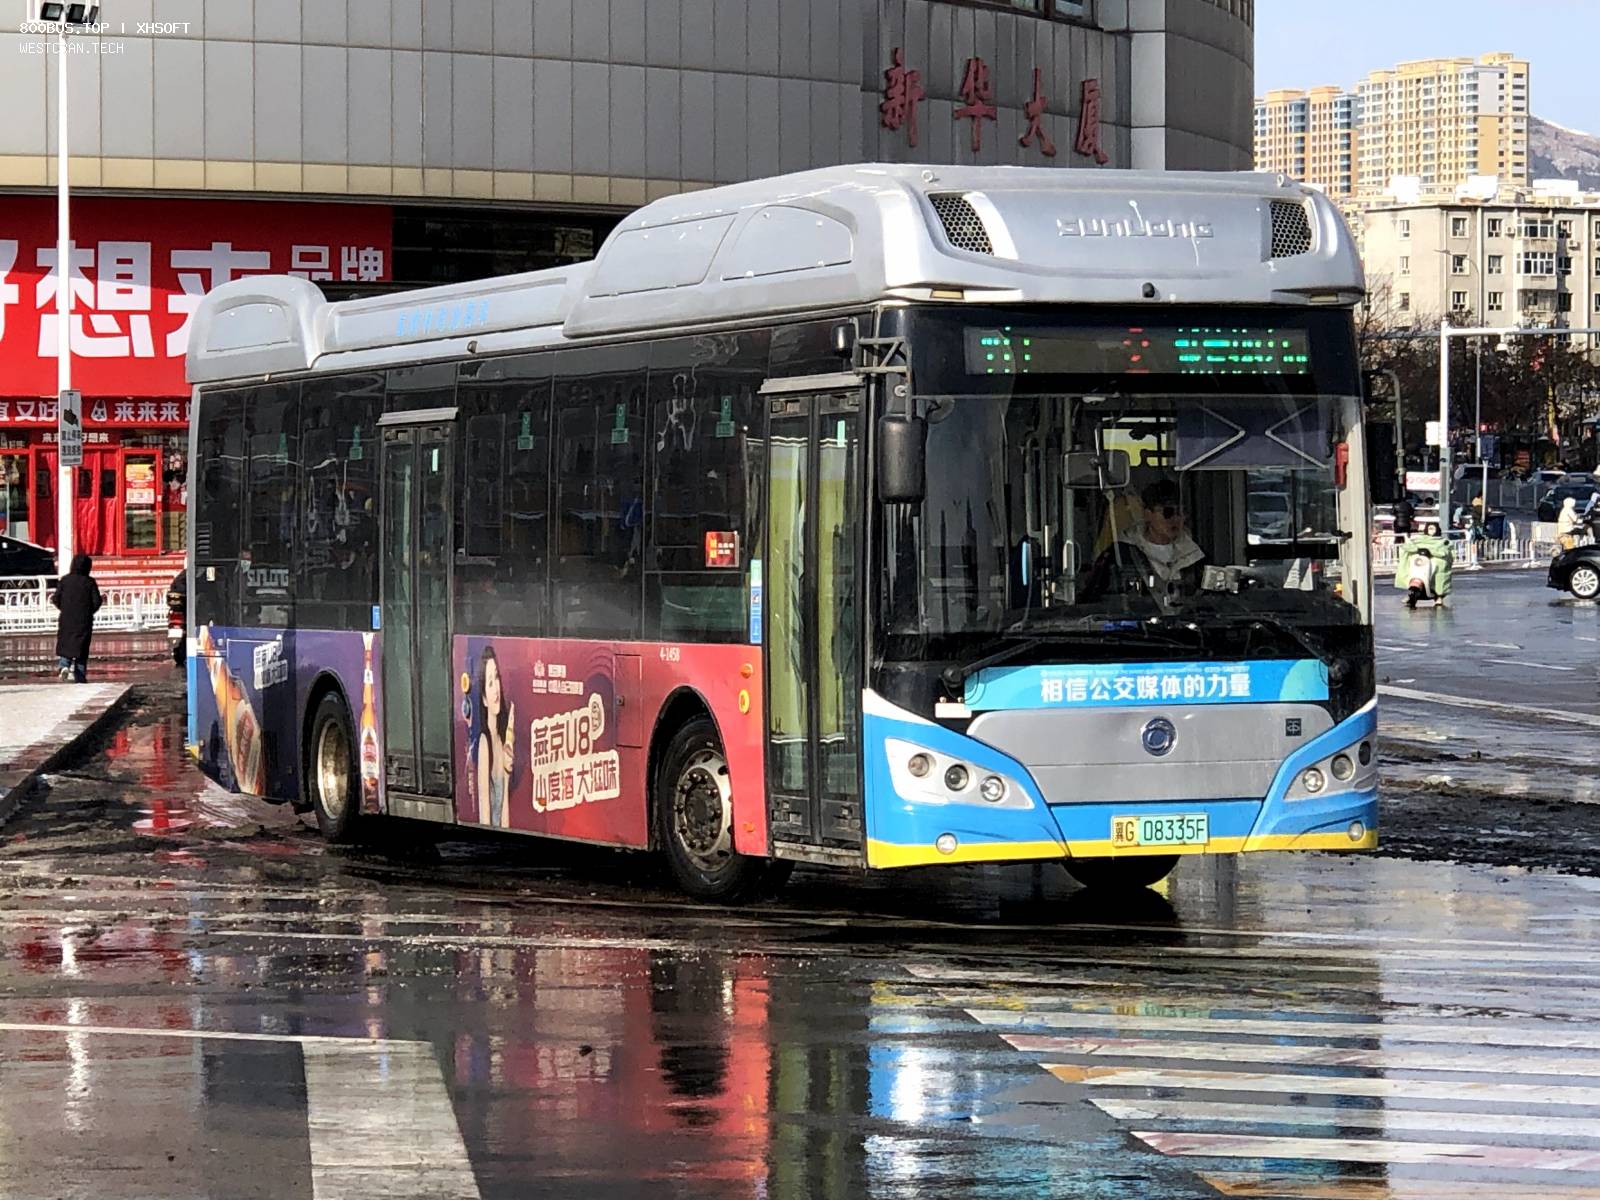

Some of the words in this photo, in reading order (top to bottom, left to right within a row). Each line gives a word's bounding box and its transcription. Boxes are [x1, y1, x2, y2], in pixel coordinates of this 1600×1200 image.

[1041, 673, 1251, 703] 相信公交媒体的力量
[1143, 818, 1205, 841] 08335F
